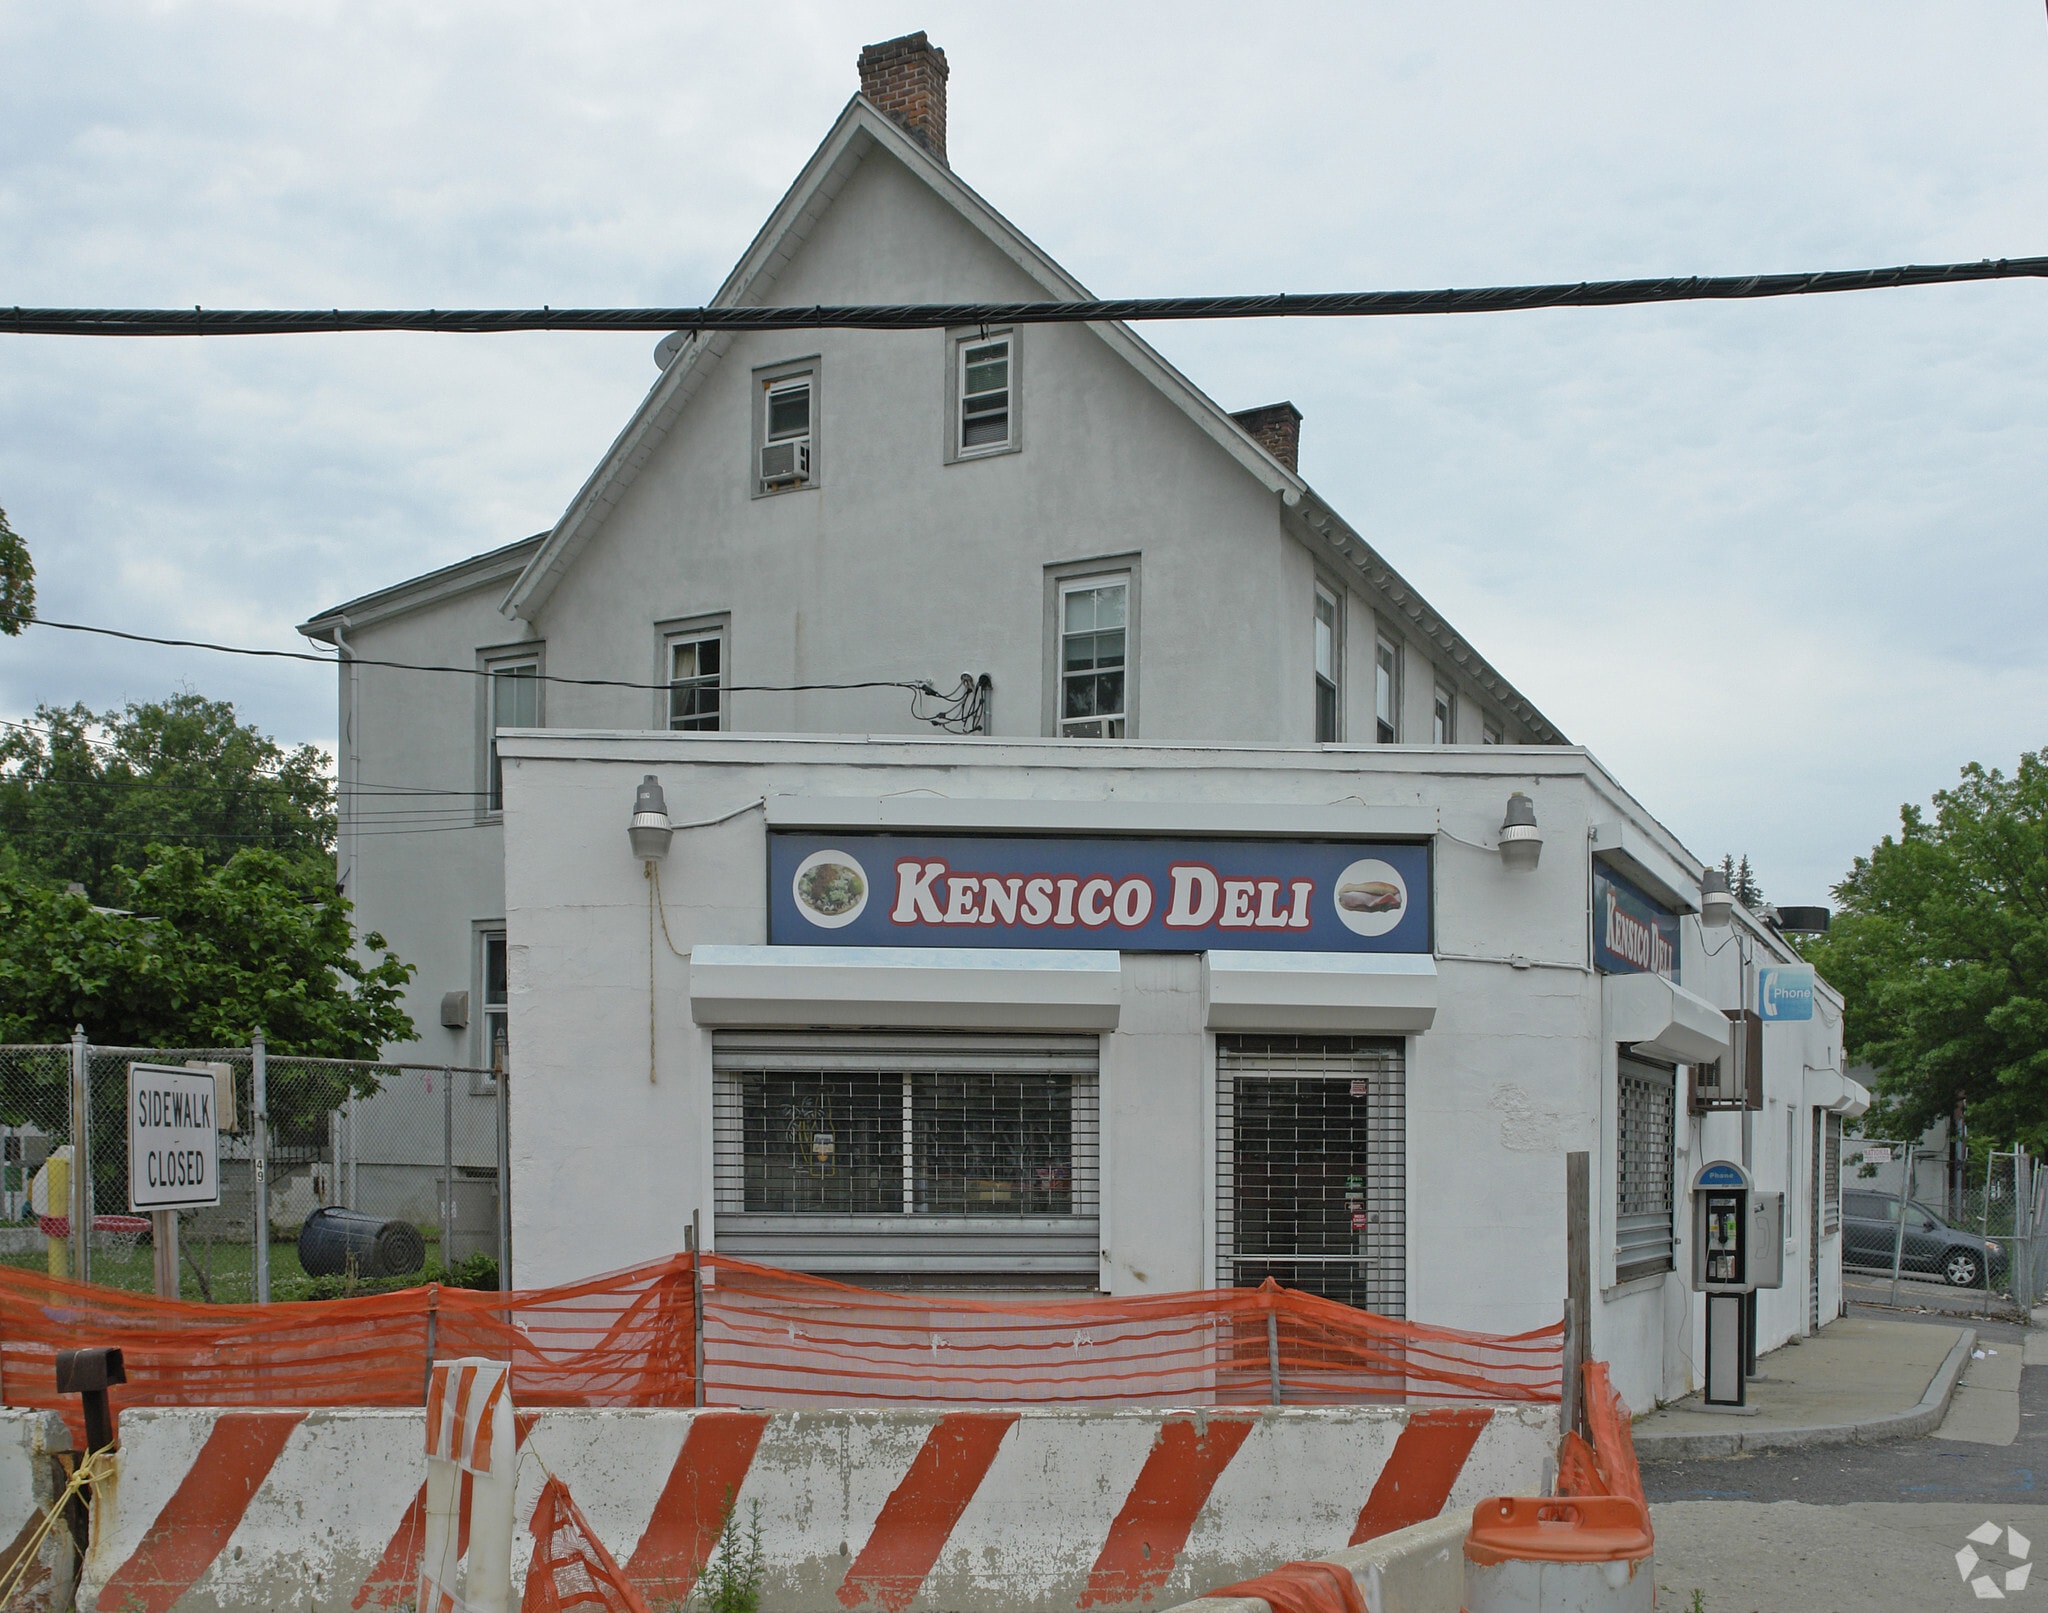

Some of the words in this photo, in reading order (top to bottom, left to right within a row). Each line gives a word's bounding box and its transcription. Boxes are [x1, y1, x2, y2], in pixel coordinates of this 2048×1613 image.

[891, 860, 1153, 928] KENSICO
[1164, 864, 1314, 929] DELI
[1605, 892, 1650, 969] KENSICO
[1650, 921, 1673, 981] DELI
[1773, 987, 1812, 999] Phone
[138, 1089, 211, 1129] SIDEWALK
[147, 1150, 205, 1188] CLOSED
[1709, 1172, 1735, 1180] Phone
